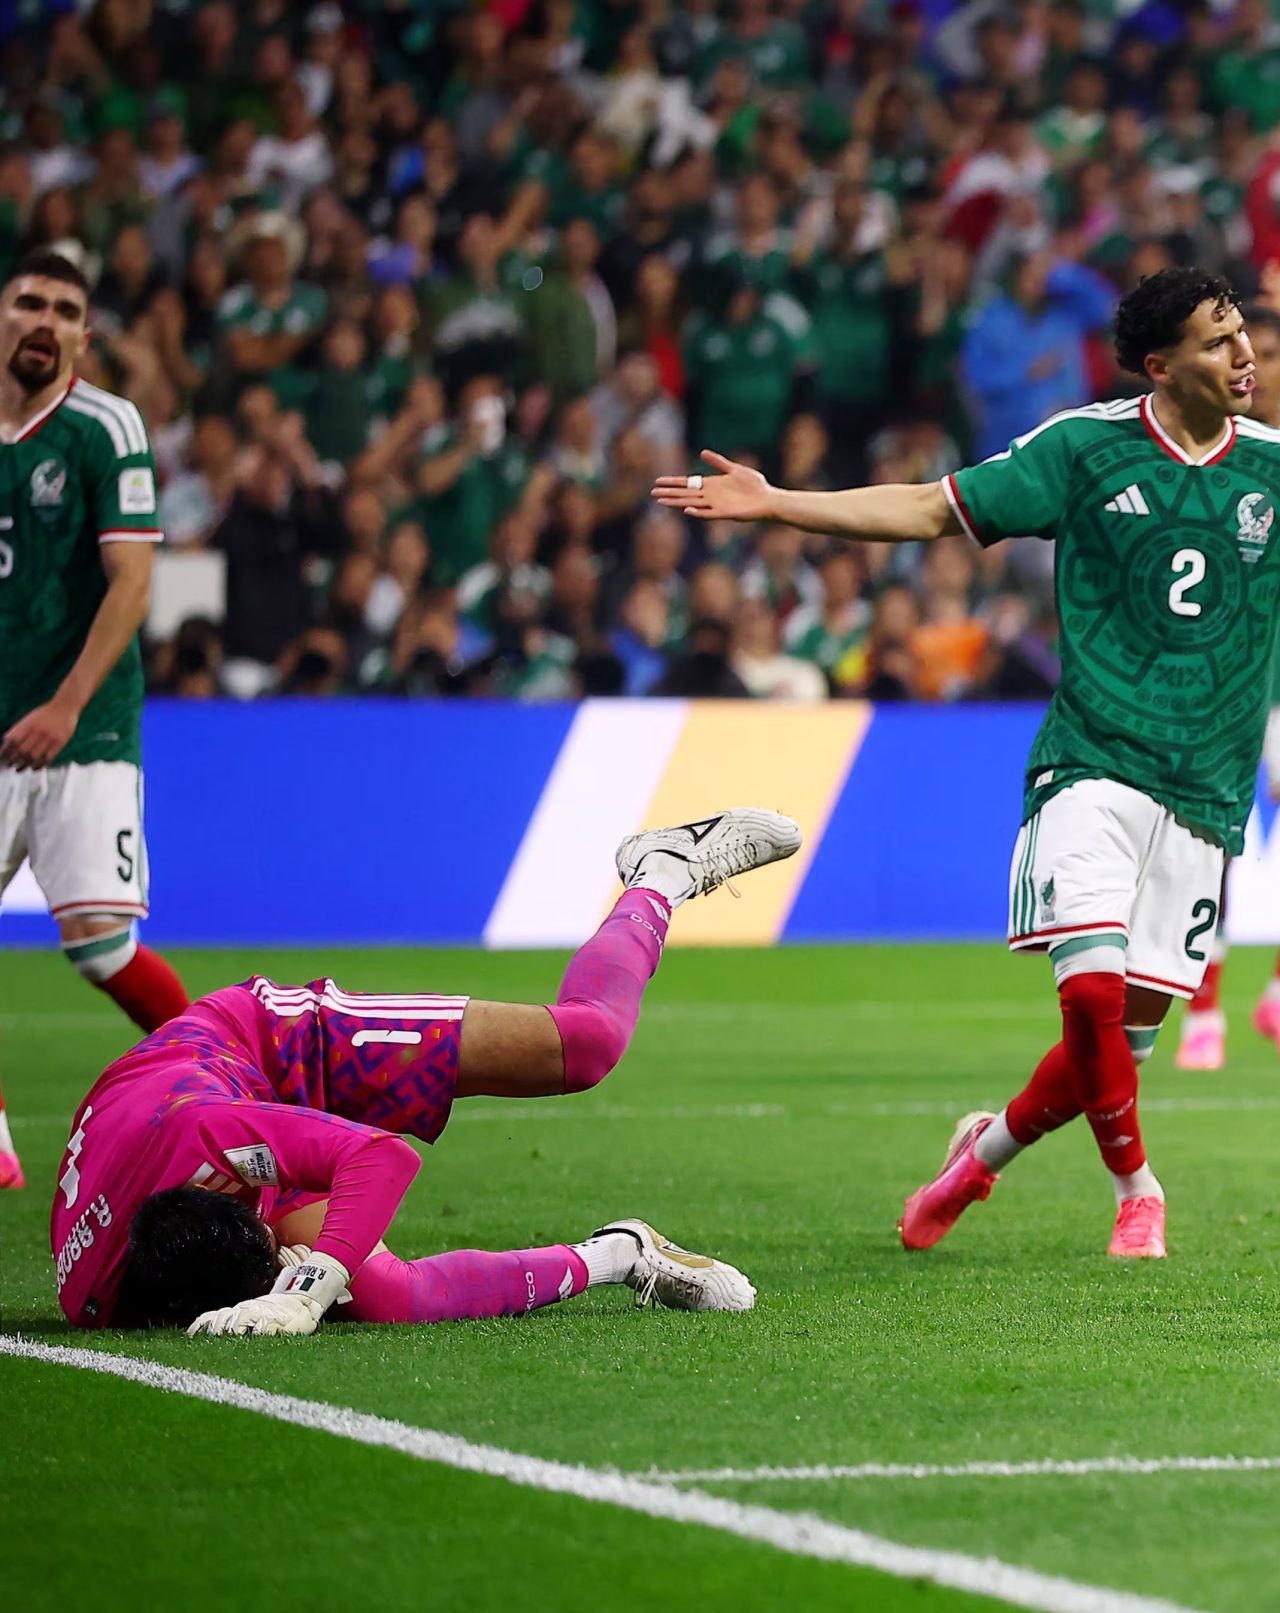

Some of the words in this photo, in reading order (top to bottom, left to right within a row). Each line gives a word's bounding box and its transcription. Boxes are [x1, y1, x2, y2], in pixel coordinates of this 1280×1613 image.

[1168, 548, 1207, 617] 2
[117, 830, 133, 882] 5
[1184, 898, 1217, 961] 2
[351, 1029, 422, 1047] 1
